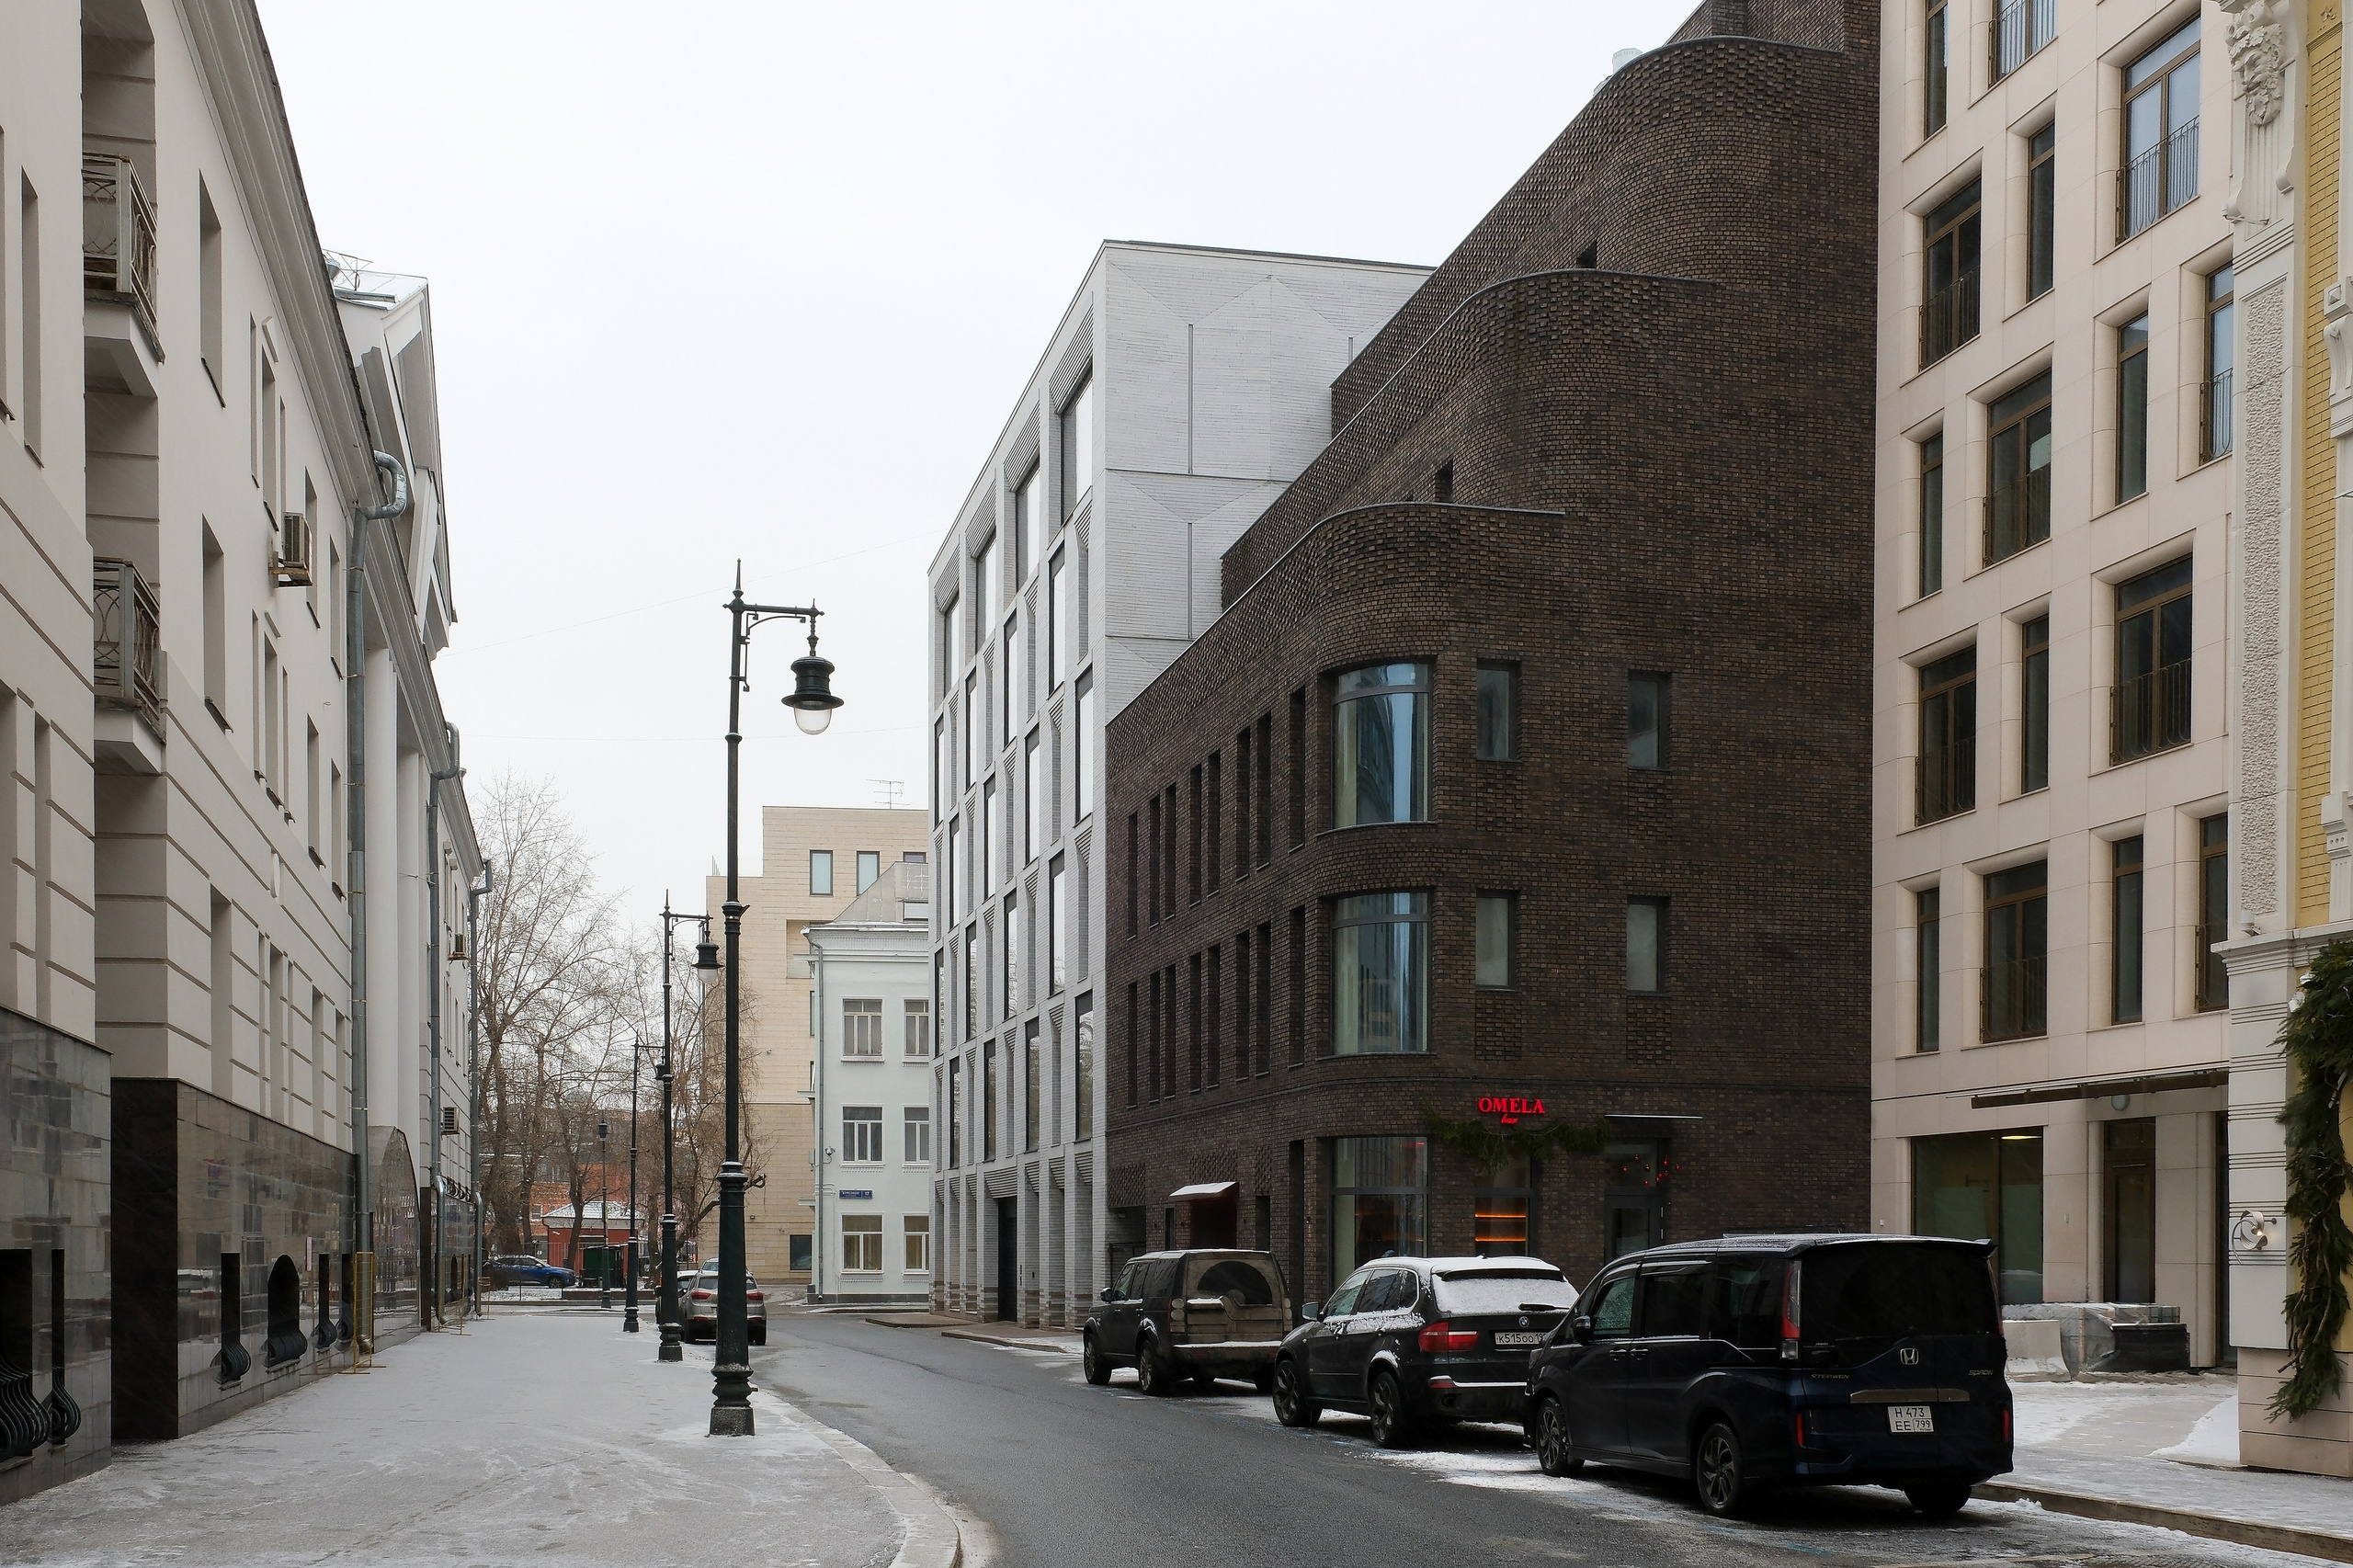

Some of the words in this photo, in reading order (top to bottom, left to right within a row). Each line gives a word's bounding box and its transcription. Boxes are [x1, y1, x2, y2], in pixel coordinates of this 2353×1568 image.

[1478, 1096, 1546, 1114] OMELA
[1501, 1113, 1518, 1124] bar
[1905, 1407, 1925, 1418] 473
[1915, 1419, 1930, 1428] 799
